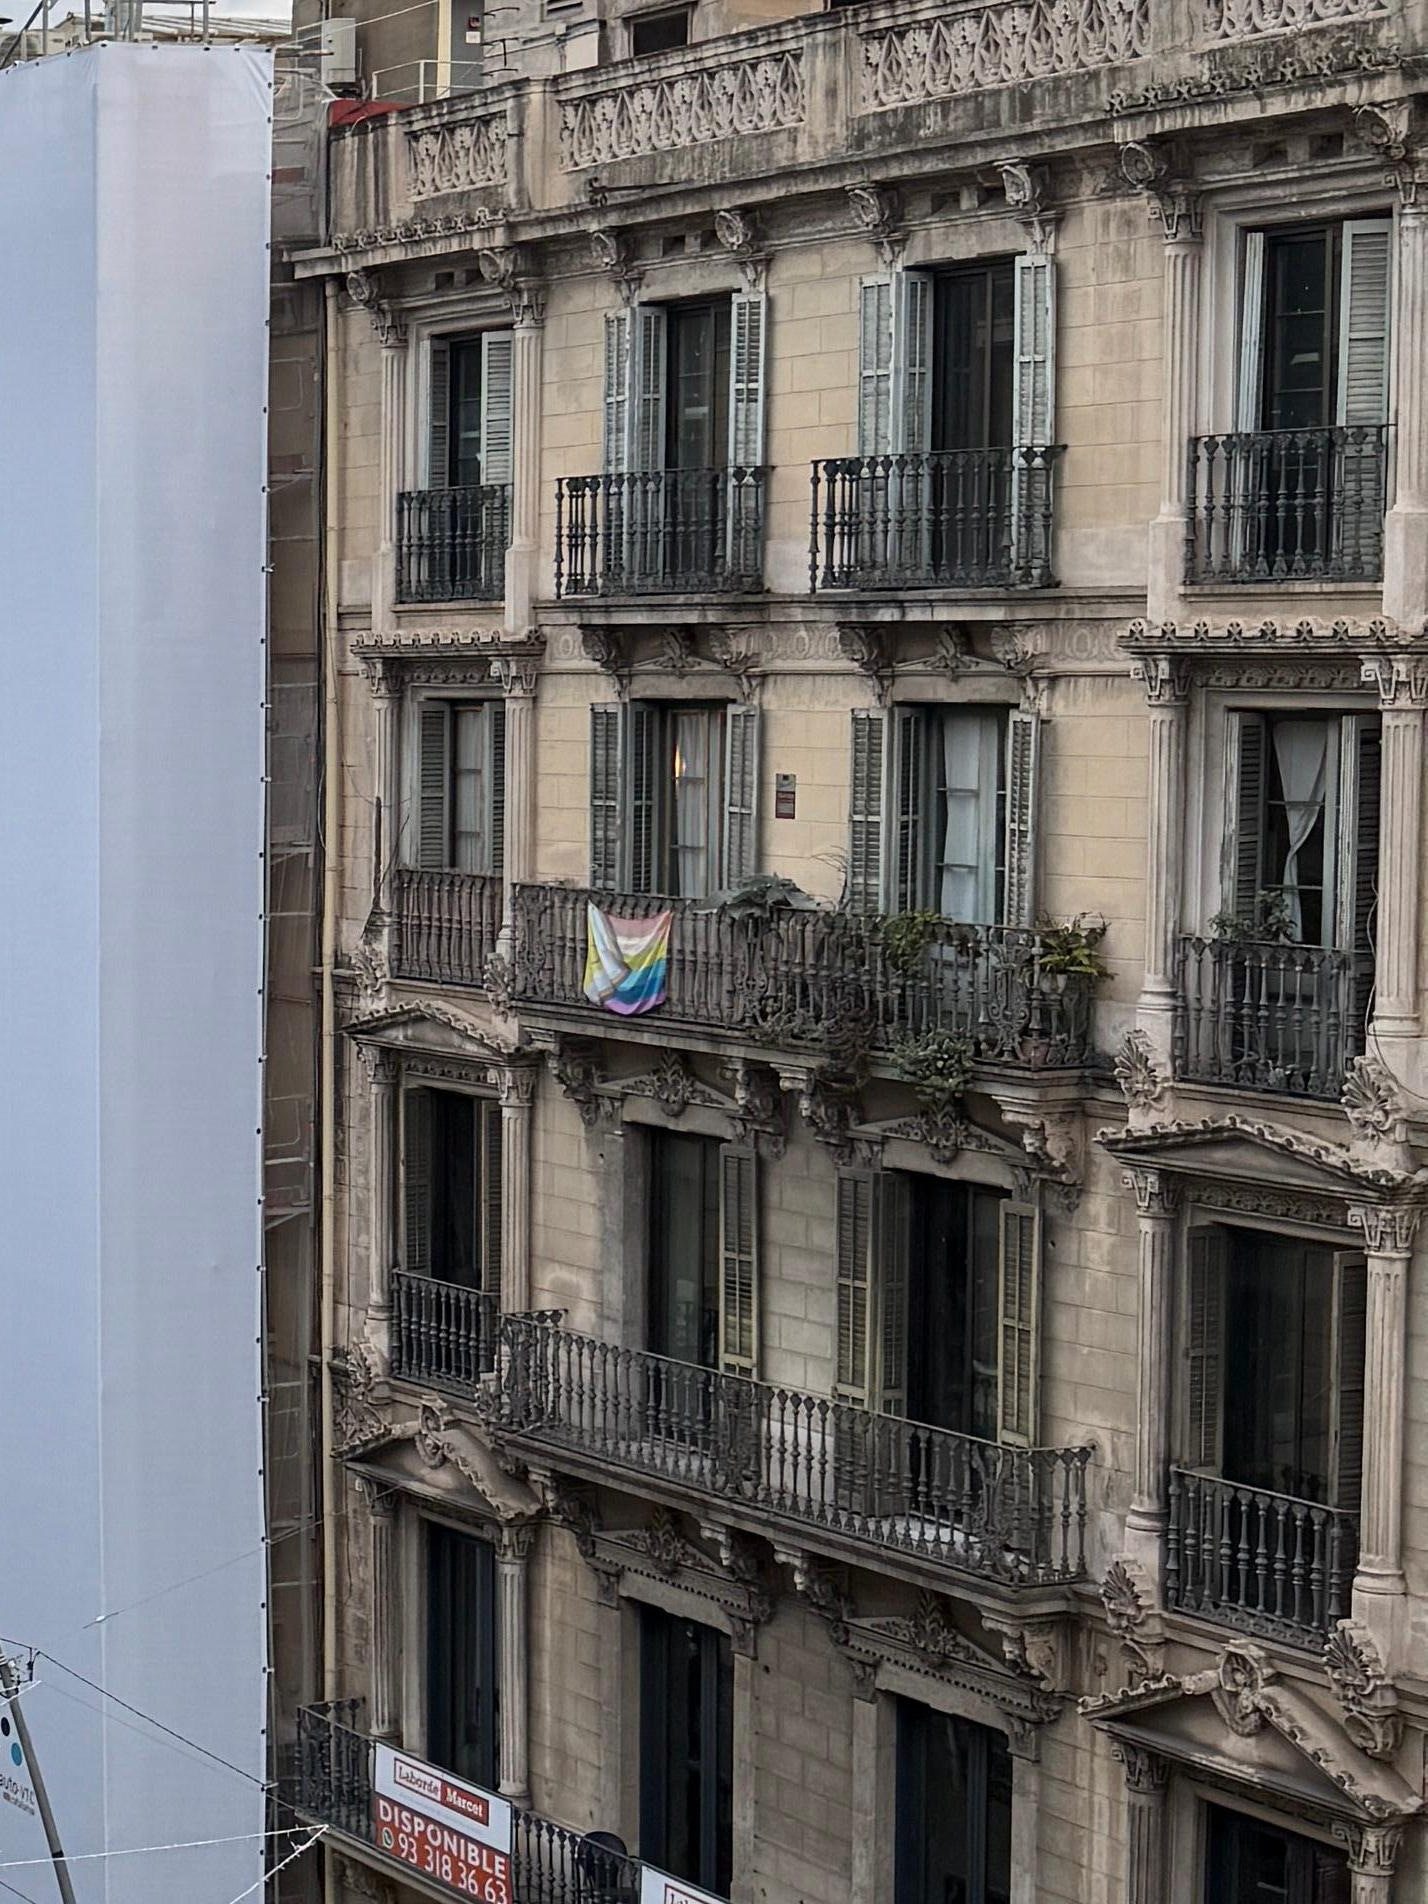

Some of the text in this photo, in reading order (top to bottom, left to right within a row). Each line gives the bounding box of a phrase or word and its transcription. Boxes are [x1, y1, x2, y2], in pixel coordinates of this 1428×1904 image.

[399, 1765, 440, 1796] Laborde
[446, 1787, 484, 1818] Marcet
[379, 1799, 507, 1881] DISPONIBLE
[398, 1833, 418, 1865] 93
[424, 1845, 452, 1882] 318
[458, 1861, 479, 1896] 36
